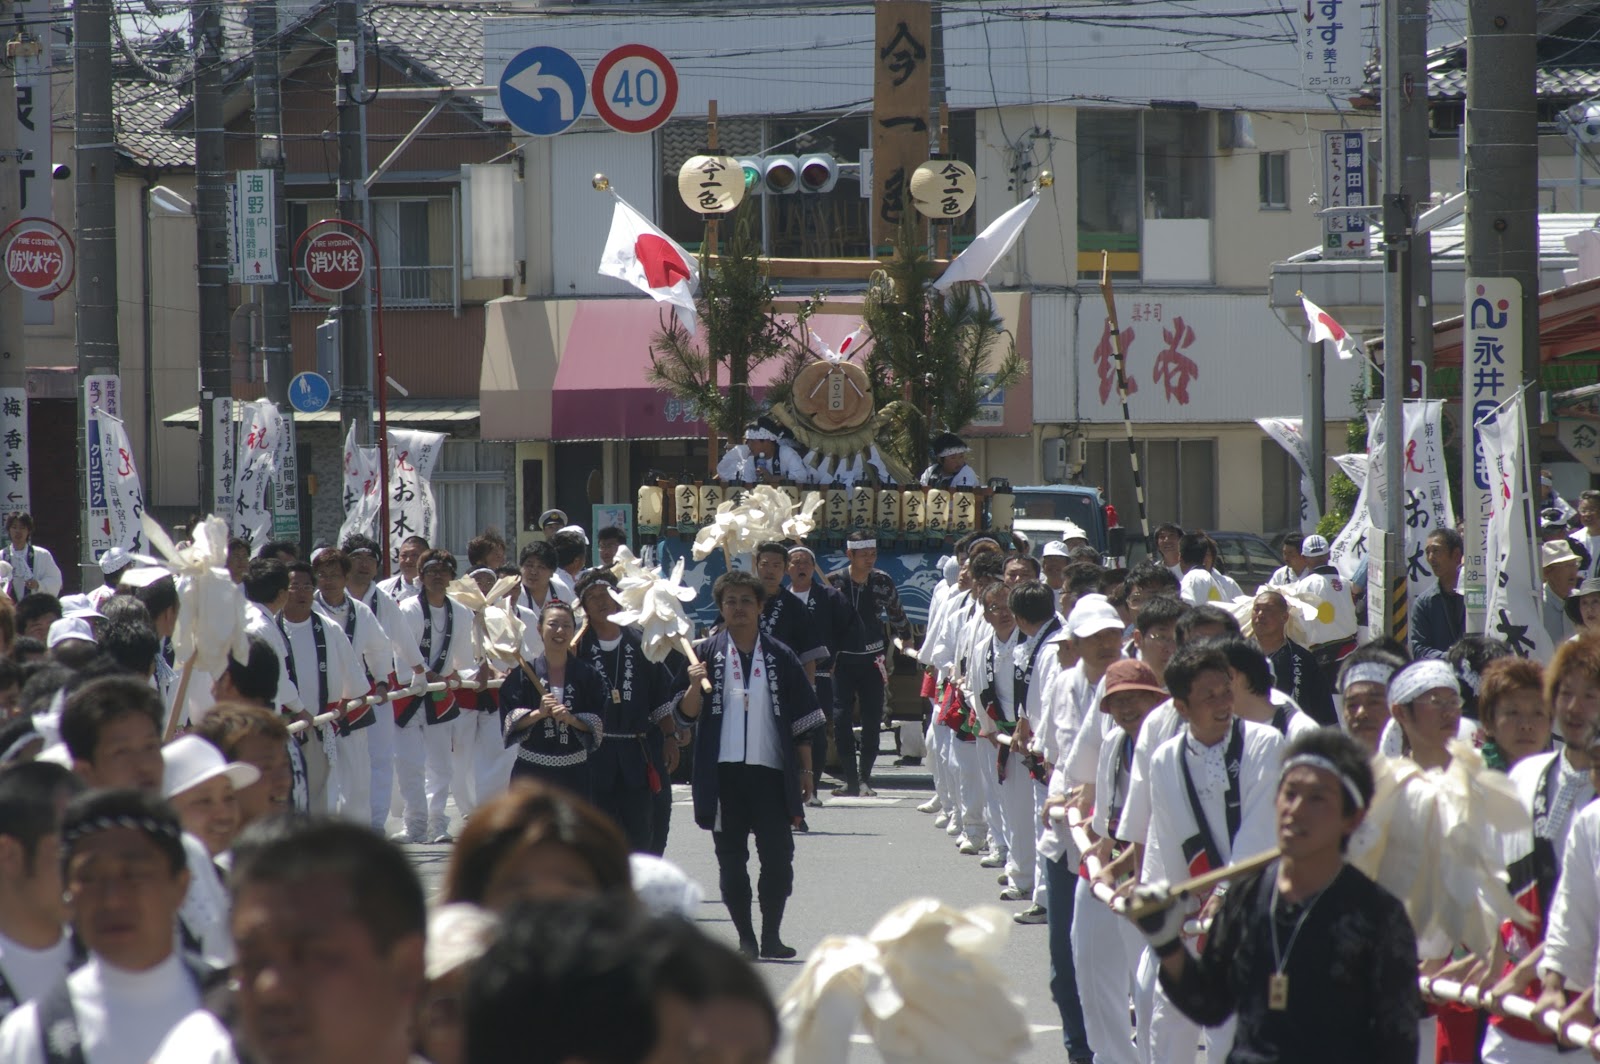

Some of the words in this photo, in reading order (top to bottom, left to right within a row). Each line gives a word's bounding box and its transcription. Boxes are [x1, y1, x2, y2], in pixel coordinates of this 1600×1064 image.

[612, 68, 659, 108] 40
[1308, 76, 1352, 86] 25-1873
[247, 174, 264, 215] 海野
[697, 157, 726, 211] 今一色
[938, 162, 967, 216] 今一色
[17, 237, 32, 245] FIRE
[257, 217, 268, 259] 内科
[314, 240, 327, 248] FIRE
[327, 240, 353, 248] HYDRANT
[9, 249, 62, 275] 防火水そう
[310, 249, 360, 274] 消火栓
[1472, 335, 1506, 398] 永井
[105, 380, 117, 417] 形成外科
[2, 395, 24, 483] 梅香寺
[246, 424, 270, 450] 祝
[90, 443, 104, 506] クリニック
[680, 486, 696, 526] 今一色
[829, 492, 845, 532] 今一色
[854, 489, 871, 530] 今一色
[880, 492, 897, 532] 今一色
[906, 495, 922, 533] 今一色
[930, 492, 947, 532] 今一色
[955, 495, 972, 534] 今一色
[313, 622, 327, 672] 今一色
[622, 643, 635, 701] 今一色奉献団
[711, 650, 726, 715] 今一色木遣班
[559, 683, 575, 745] 今一色献団
